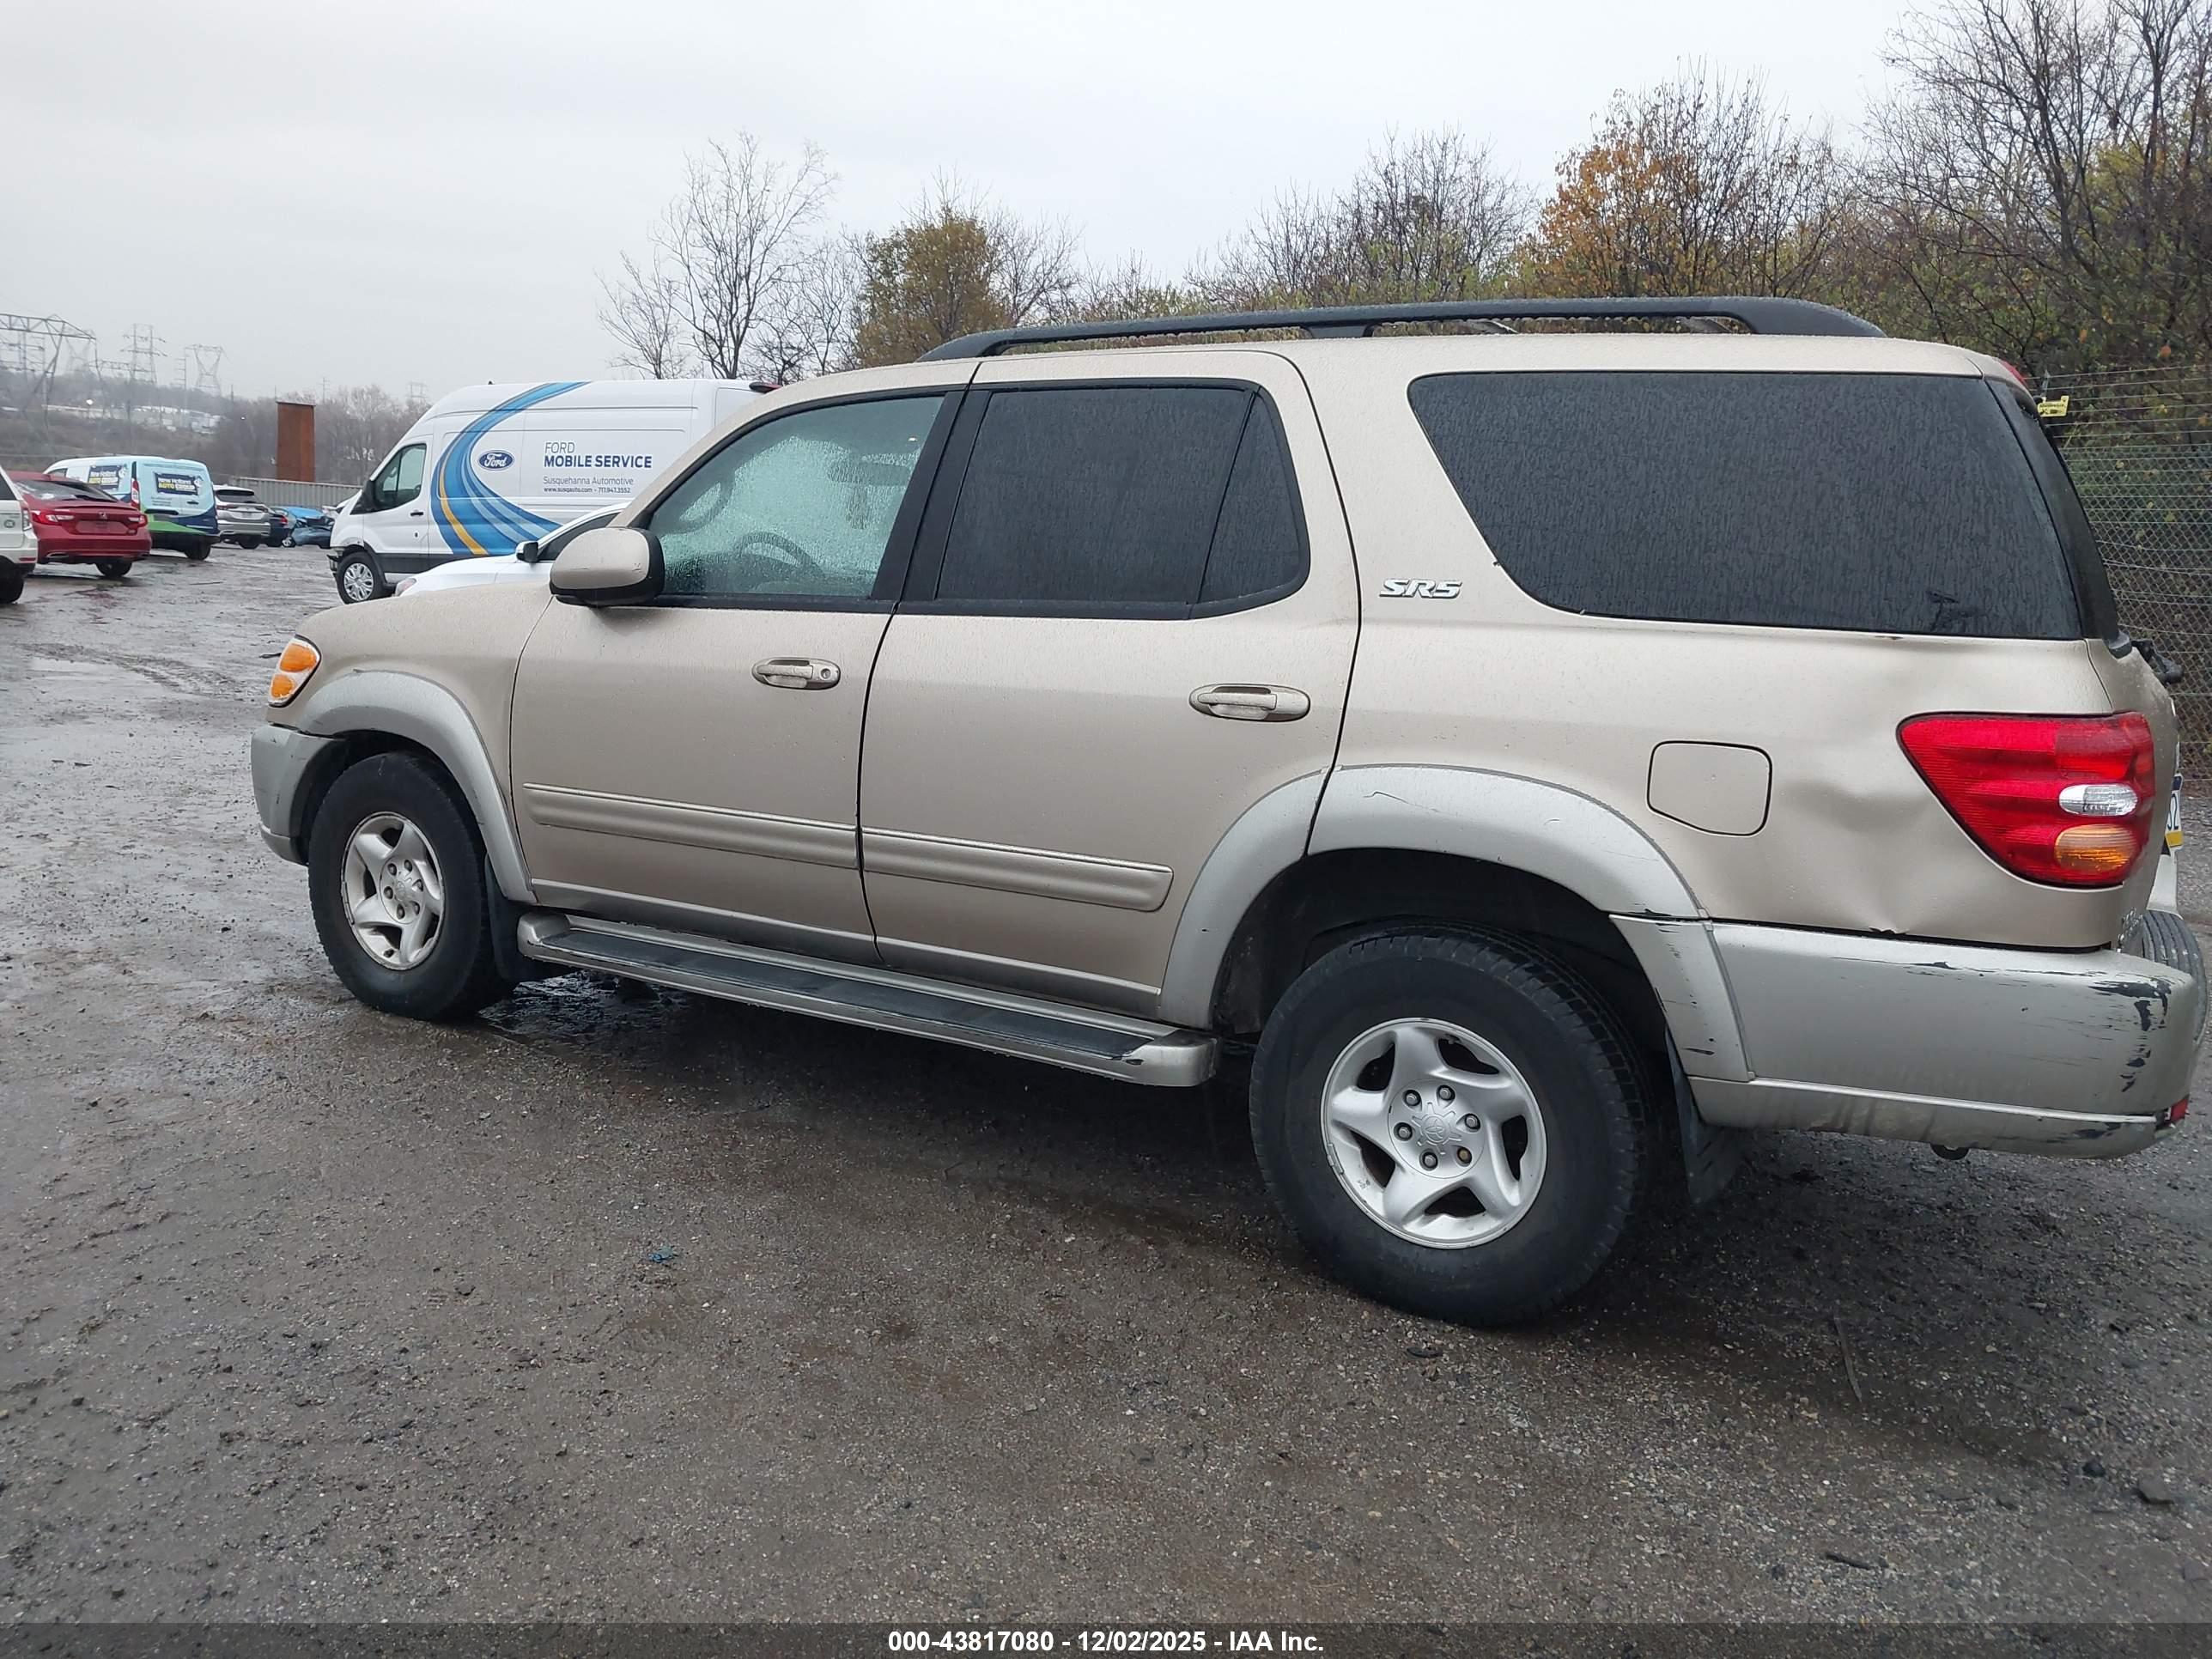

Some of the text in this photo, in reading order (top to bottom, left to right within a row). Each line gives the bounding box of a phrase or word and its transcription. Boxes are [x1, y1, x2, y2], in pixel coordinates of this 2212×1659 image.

[544, 441, 575, 453] FORD
[483, 453, 508, 467] Ford
[544, 455, 653, 468] MOBILE SERVICE
[543, 476, 634, 486] Susquehanna Automotive
[1378, 578, 1463, 599] SR5
